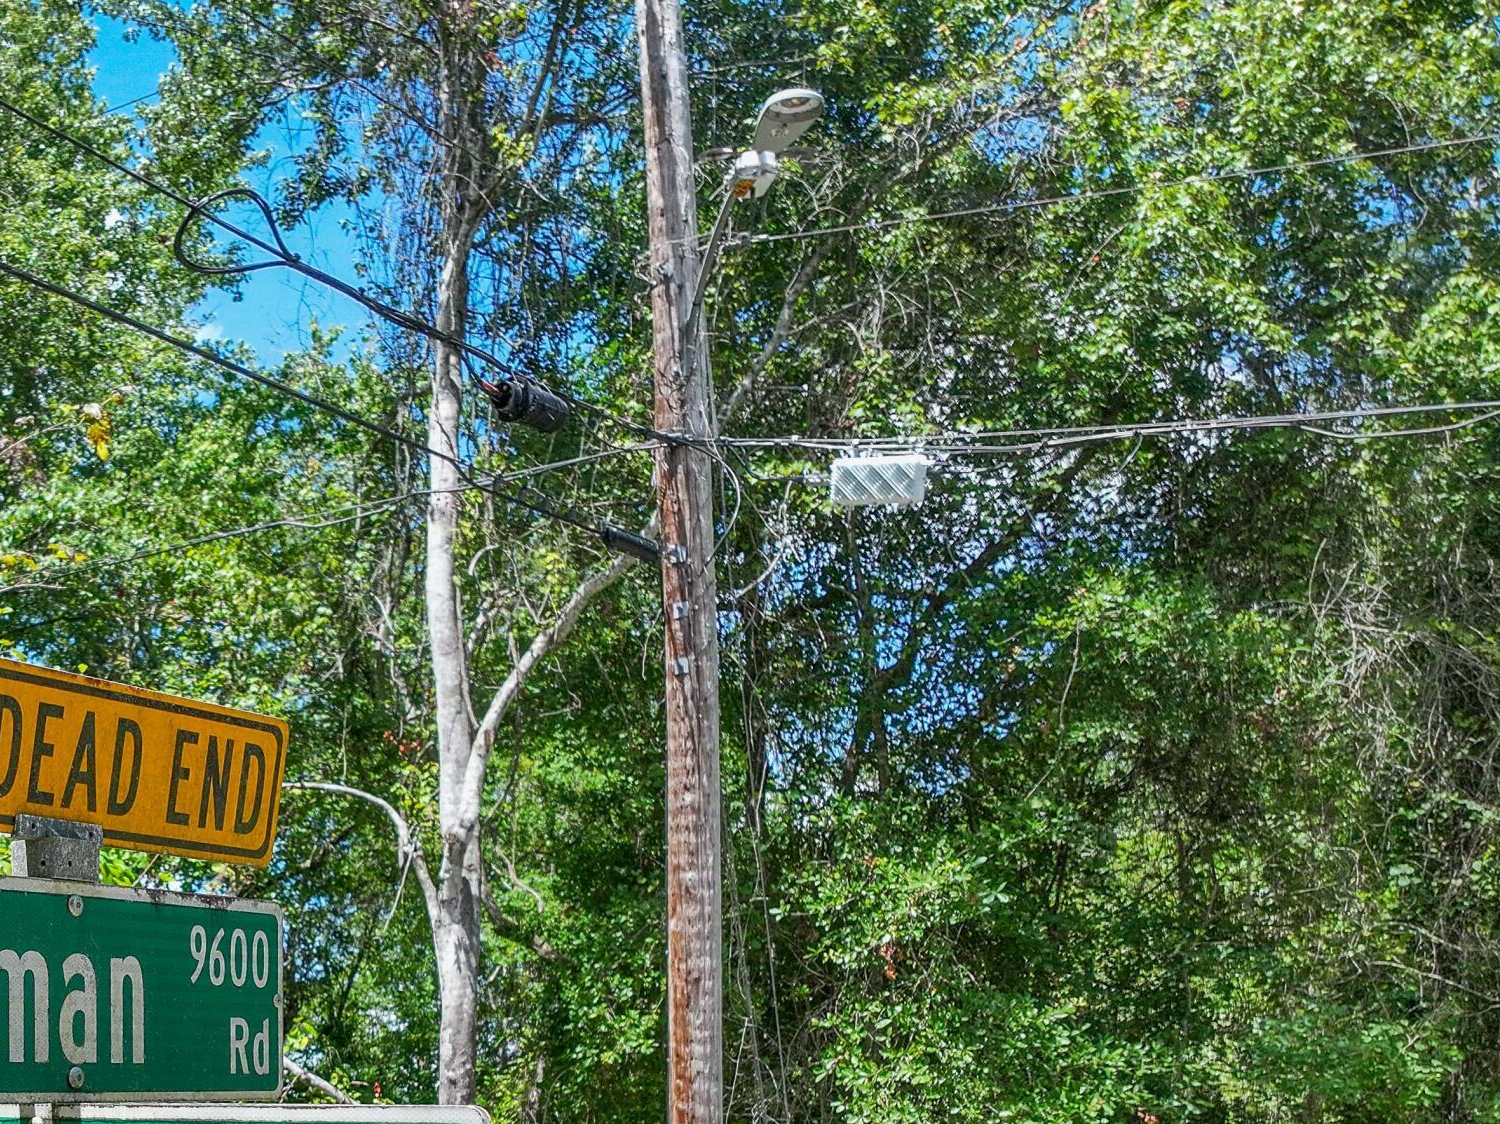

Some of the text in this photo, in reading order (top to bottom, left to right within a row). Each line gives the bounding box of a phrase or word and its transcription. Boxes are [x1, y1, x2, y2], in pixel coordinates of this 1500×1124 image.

[166, 728, 266, 835] END
[190, 924, 269, 988] 9600
[230, 1016, 270, 1076] Rd
